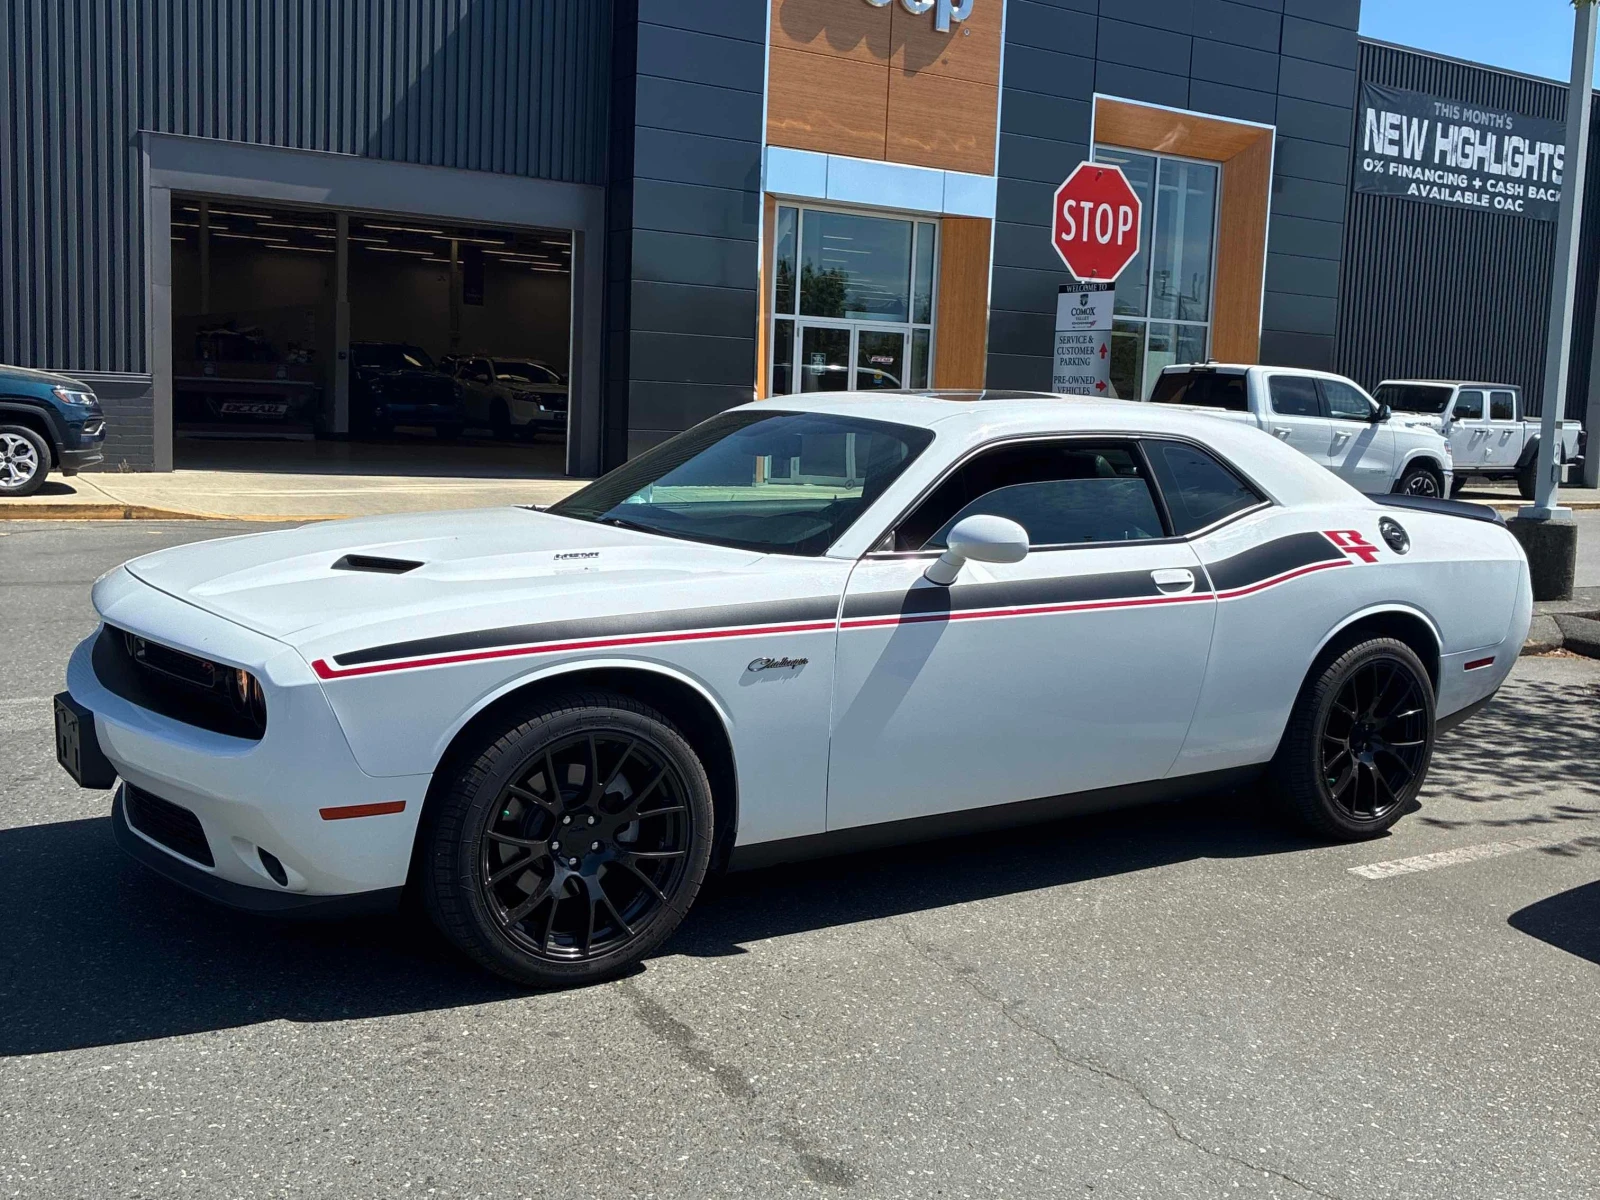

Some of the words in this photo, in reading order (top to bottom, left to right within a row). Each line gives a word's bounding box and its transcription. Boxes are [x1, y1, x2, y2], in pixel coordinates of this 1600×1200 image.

[1434, 102, 1460, 120] THIS
[1462, 109, 1513, 130] MONTH'S
[1363, 108, 1429, 161] NEW
[1434, 122, 1565, 185] HIGHLIGHTS
[1363, 158, 1384, 174] 0%
[1389, 162, 1468, 188] FINANCING
[1472, 177, 1483, 190] +
[1486, 179, 1524, 197] CASH
[1407, 182, 1490, 207] AVAILABLE
[1494, 198, 1524, 212] OAC
[1061, 199, 1133, 245] STOP
[1066, 284, 1098, 293] WELCOME
[1099, 283, 1107, 291] TO
[1071, 307, 1096, 316] COMOX
[1059, 335, 1087, 344] SERVICE
[1088, 335, 1094, 344] &
[1057, 346, 1095, 355] CUSTOMER
[1060, 358, 1091, 366] PARKING
[1053, 375, 1095, 384] PRE-OWNED
[1057, 386, 1091, 395] VEHICLES
